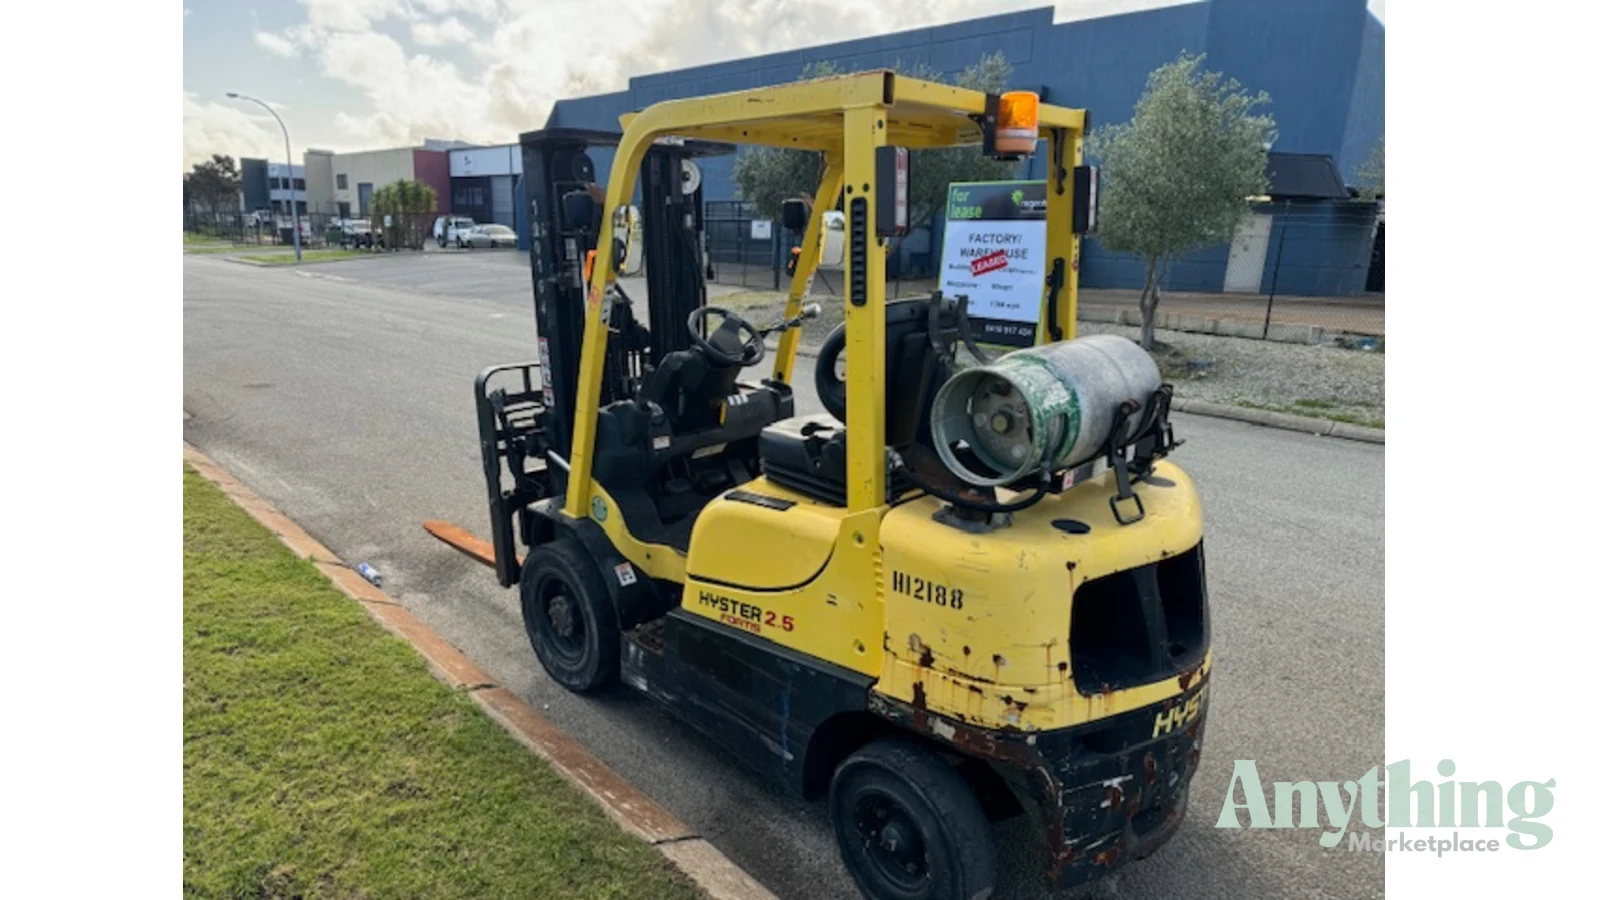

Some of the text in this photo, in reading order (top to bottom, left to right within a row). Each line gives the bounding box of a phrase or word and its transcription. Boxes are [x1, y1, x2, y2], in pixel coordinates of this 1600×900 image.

[952, 189, 970, 202] for
[951, 204, 982, 219] lease
[960, 247, 1028, 260] WAREUSE
[893, 570, 963, 611] H12188
[699, 590, 795, 632] HYSTER 2.5
[720, 612, 761, 633] FORTIS
